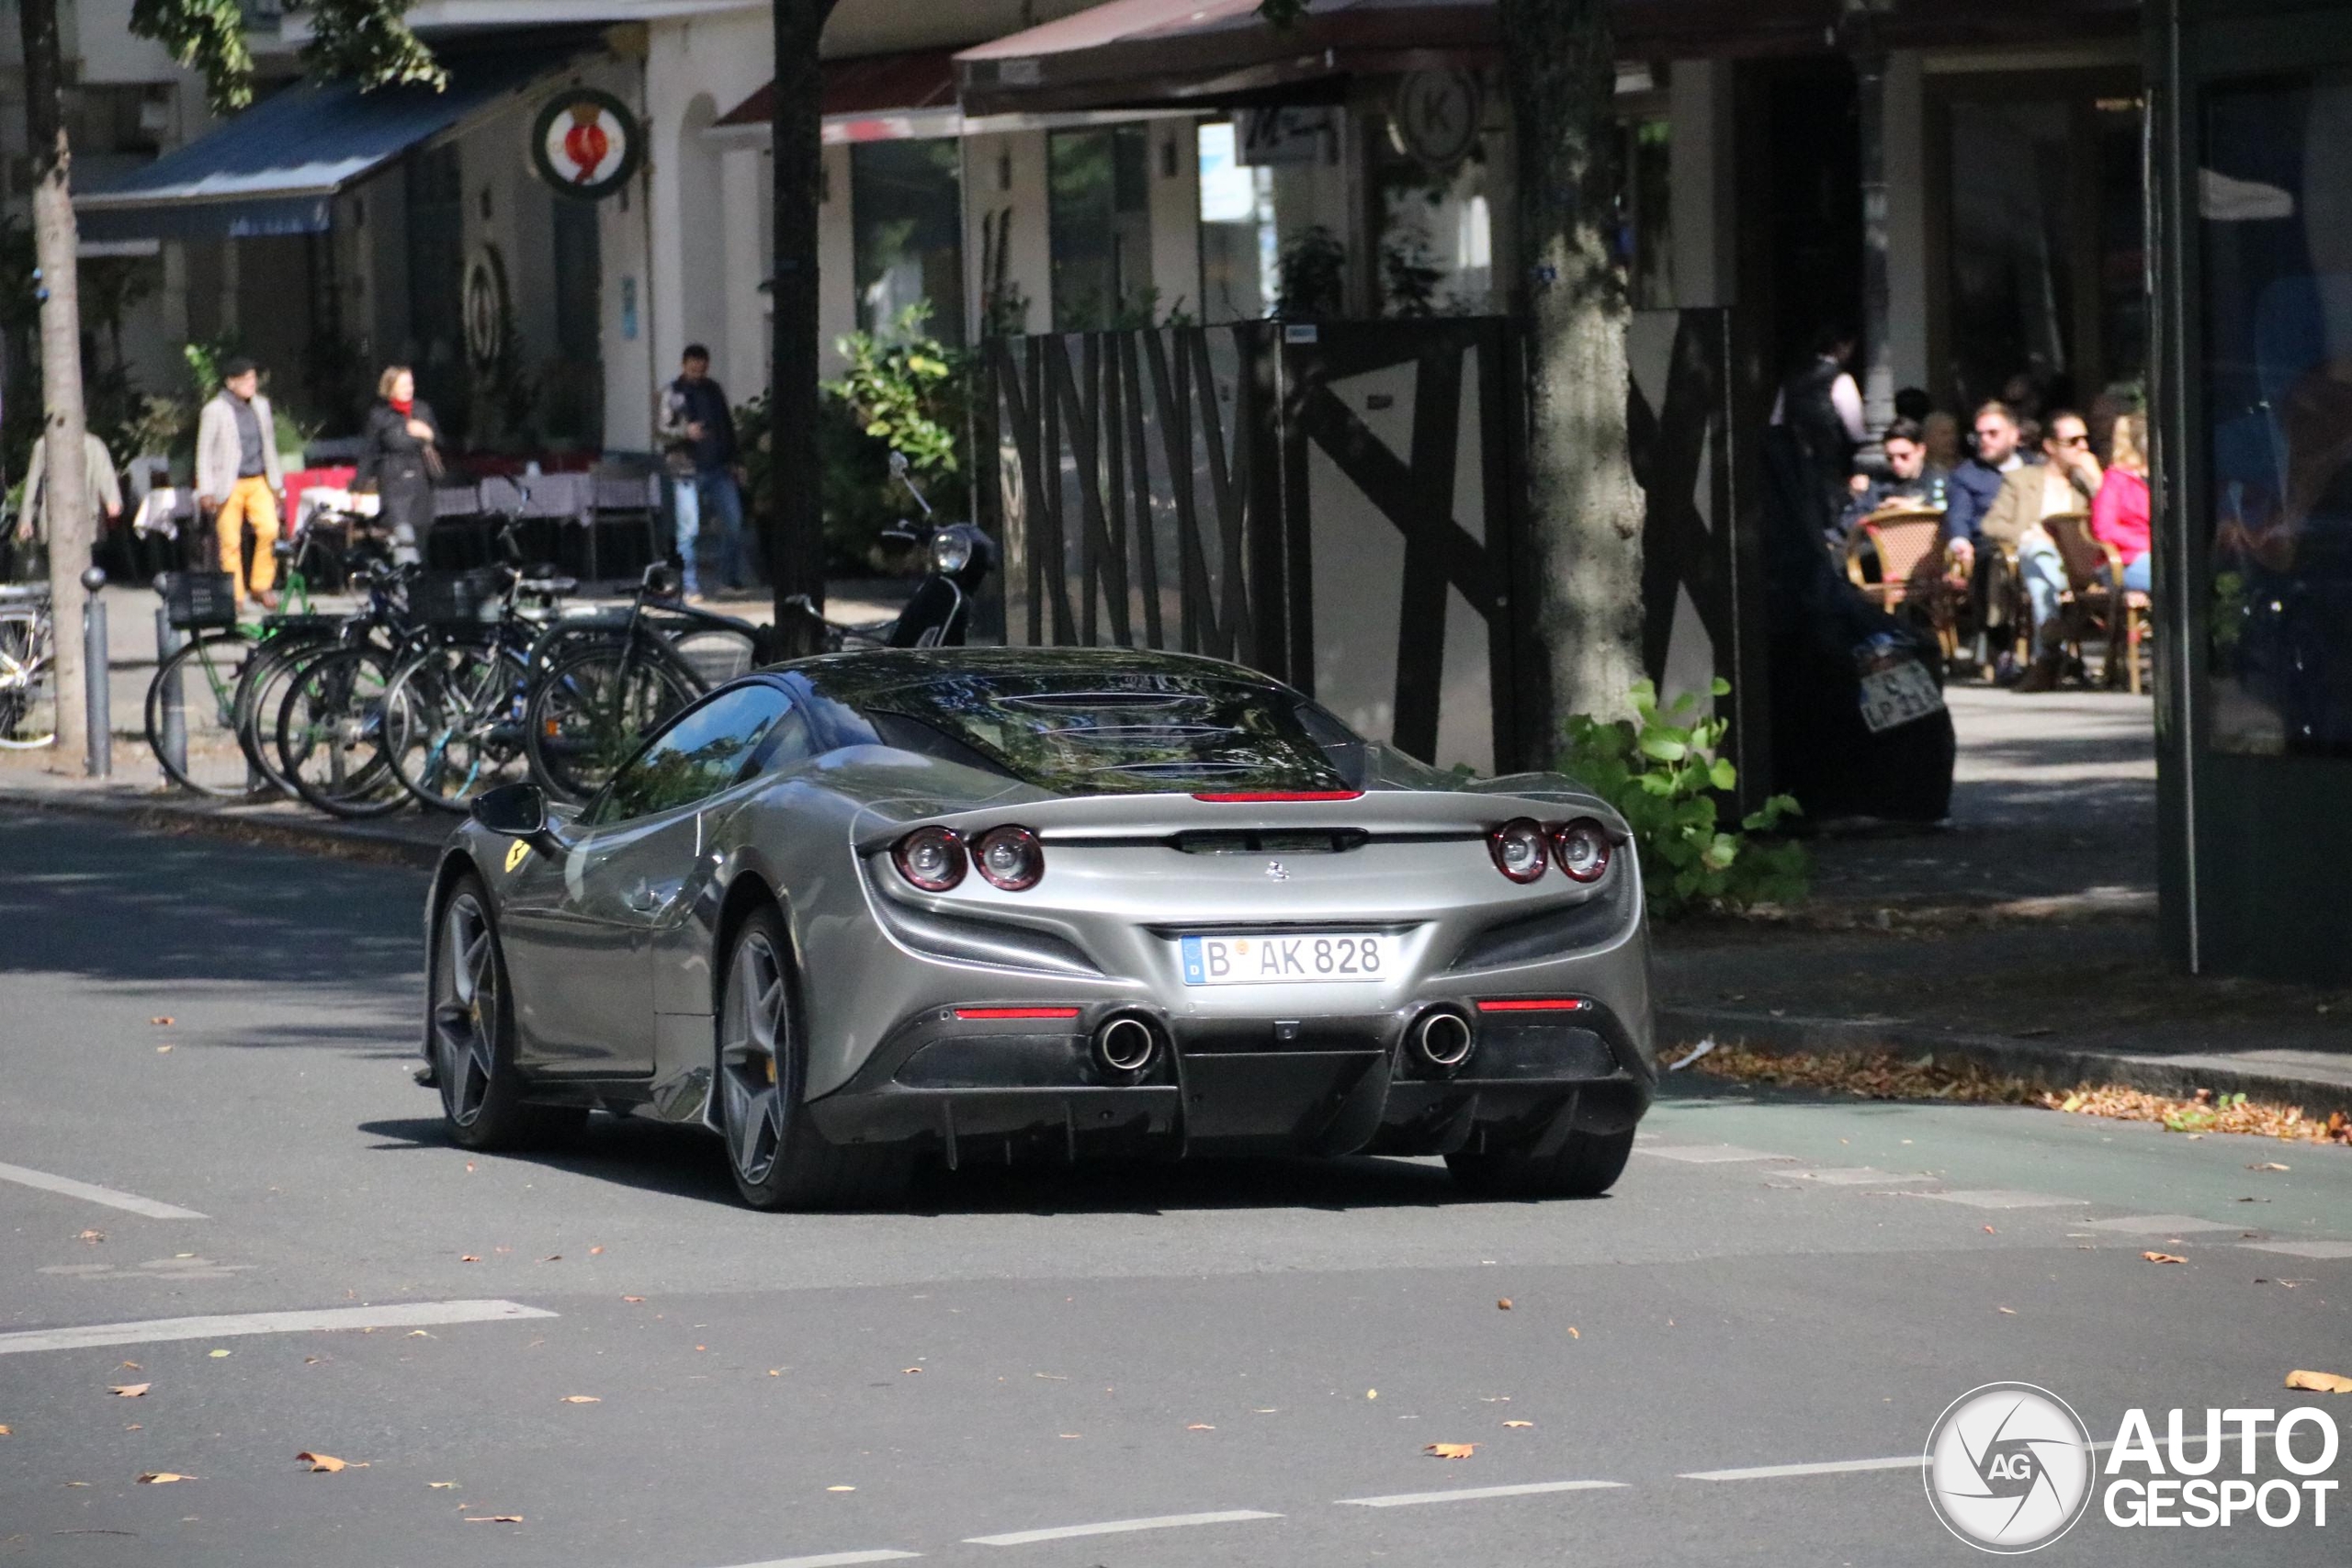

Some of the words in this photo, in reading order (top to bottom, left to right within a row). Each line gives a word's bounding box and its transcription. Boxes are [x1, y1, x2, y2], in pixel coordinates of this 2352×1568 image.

[1423, 89, 1453, 131] K
[1190, 964, 1200, 976] D
[1207, 942, 1230, 976] B
[1261, 940, 1305, 975] AK
[1314, 938, 1380, 974] 828
